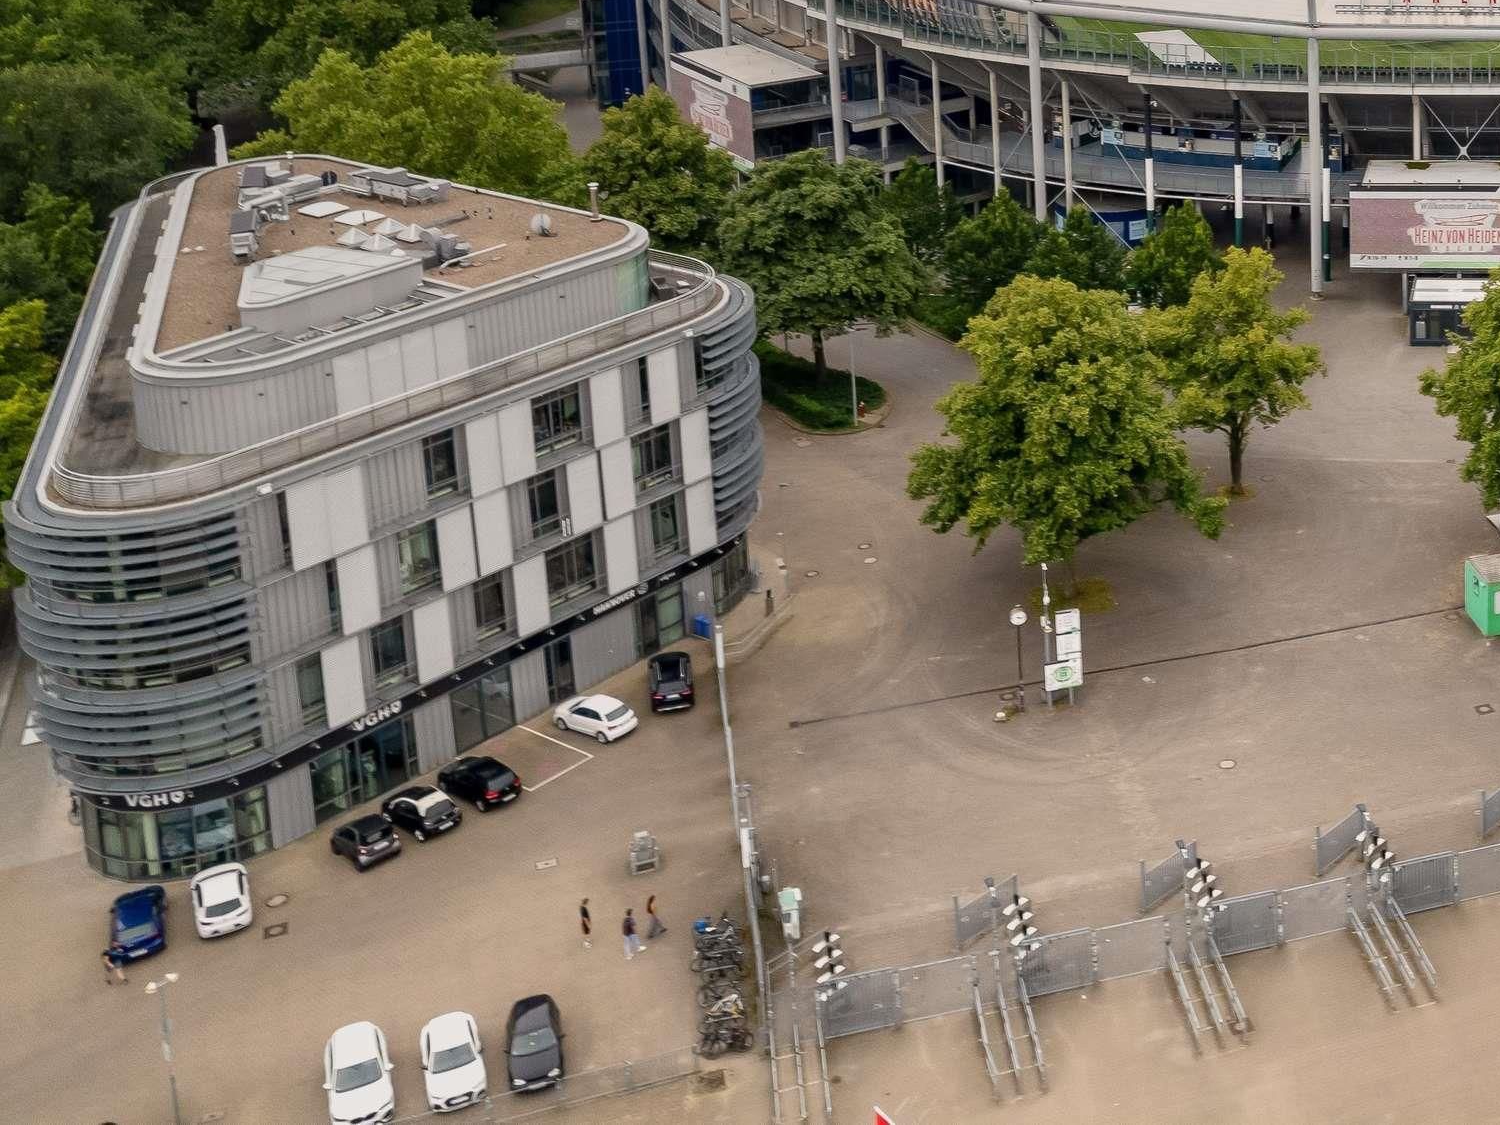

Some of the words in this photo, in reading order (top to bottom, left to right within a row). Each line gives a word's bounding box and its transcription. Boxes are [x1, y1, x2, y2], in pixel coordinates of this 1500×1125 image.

[1414, 227, 1443, 244] HEINZ
[1446, 229, 1465, 244] VON
[351, 705, 391, 732] VGH
[124, 793, 169, 808] VGH
